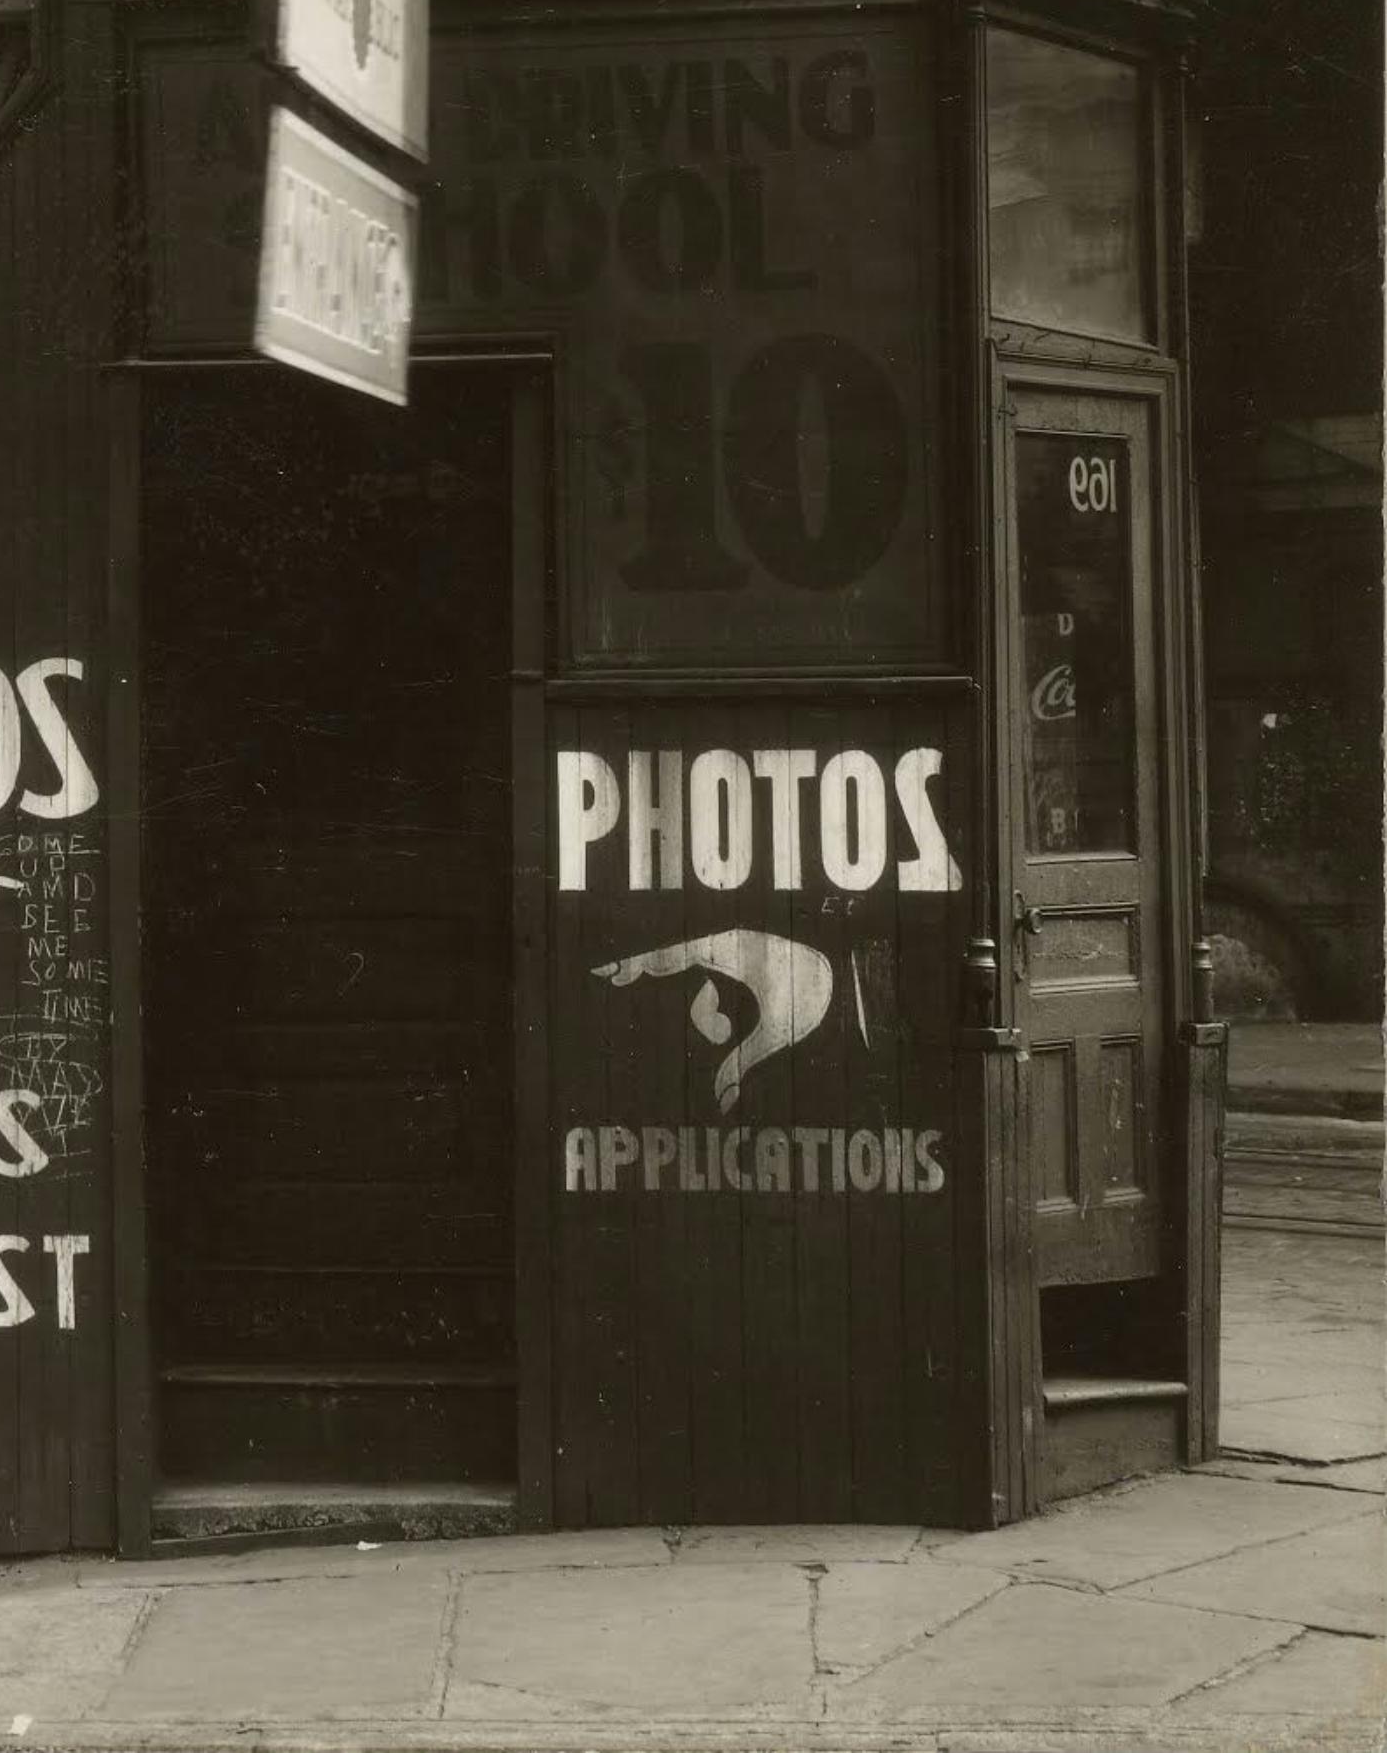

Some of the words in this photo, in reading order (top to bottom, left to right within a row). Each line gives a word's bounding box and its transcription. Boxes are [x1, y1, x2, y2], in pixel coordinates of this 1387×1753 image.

[557, 747, 963, 892] PHOTOS
[20, 854, 66, 879] UP
[28, 935, 69, 959] ME
[21, 959, 109, 987] SOME
[565, 1126, 945, 1194] APPLICATIONS
